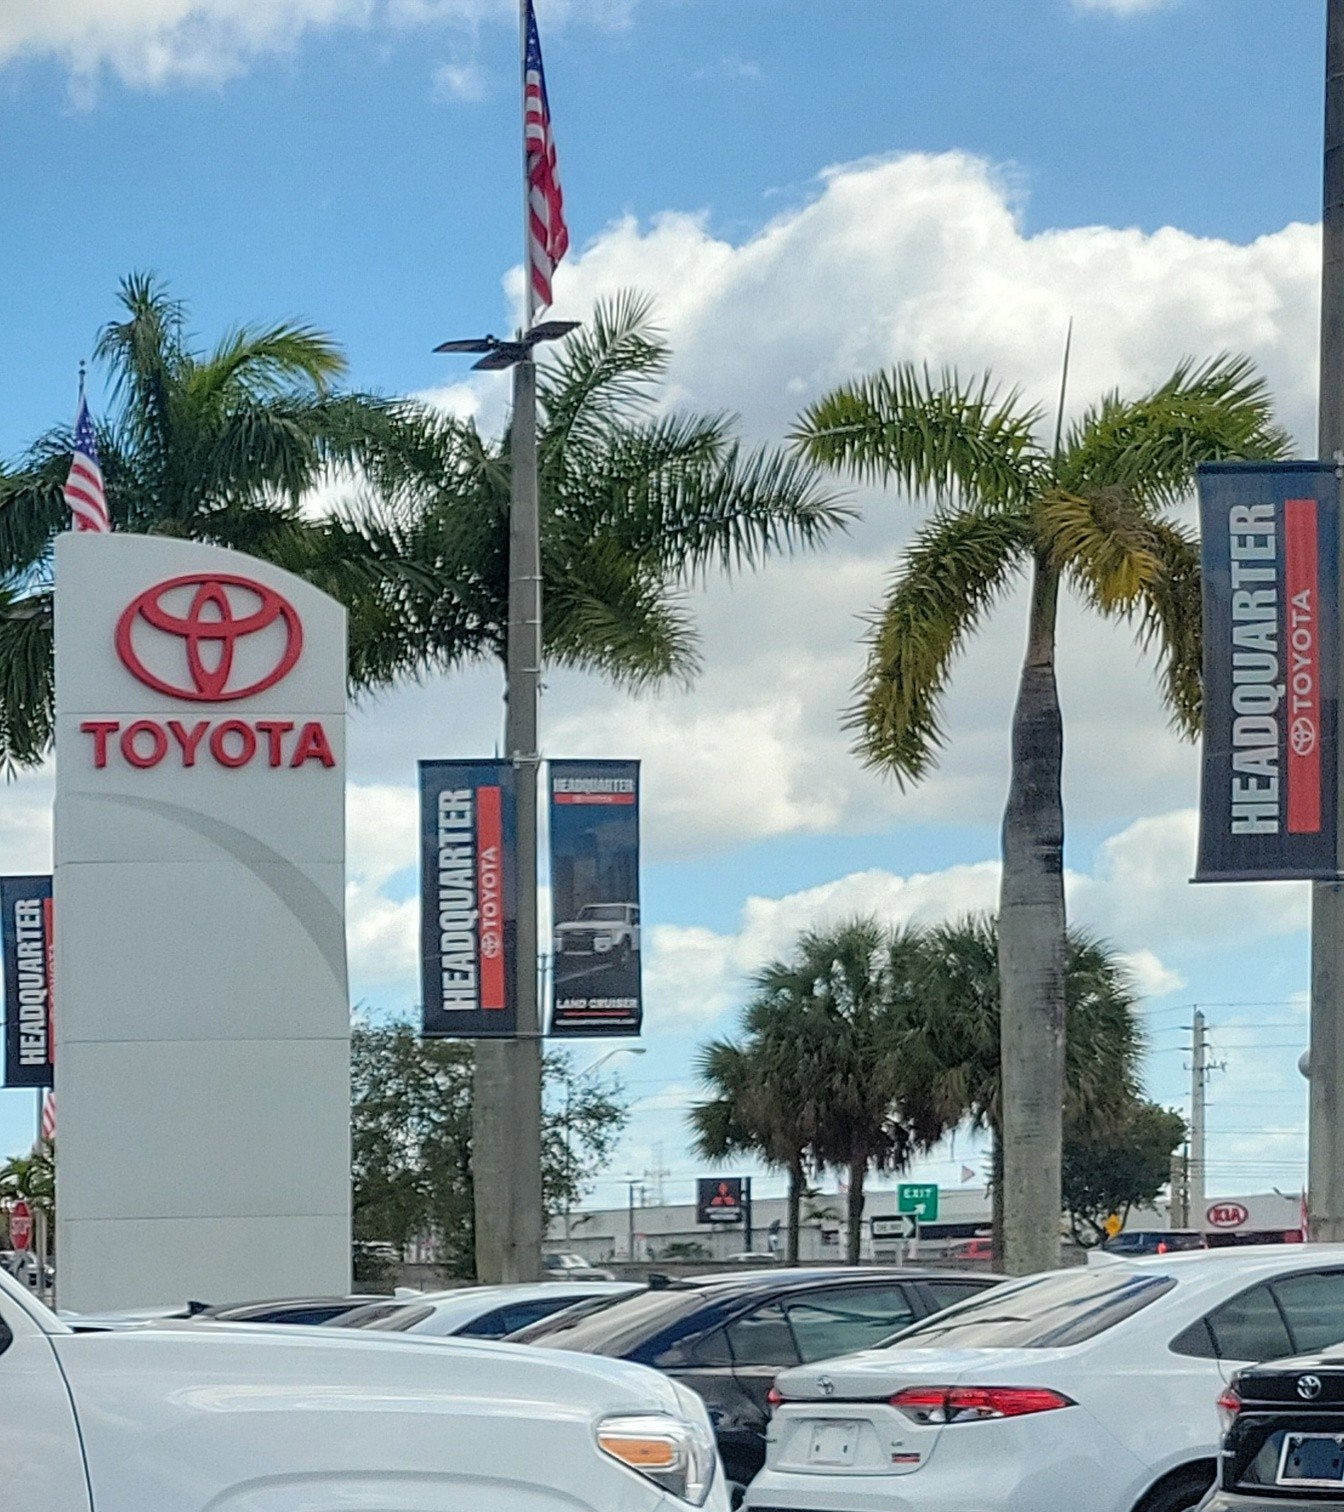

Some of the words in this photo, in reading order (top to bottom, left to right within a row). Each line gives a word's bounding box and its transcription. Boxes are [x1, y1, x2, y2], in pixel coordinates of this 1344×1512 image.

[1229, 502, 1285, 835] HEADQUARTER
[1291, 588, 1314, 714] TOYOTA
[80, 719, 336, 770] TOYOTA
[553, 777, 635, 794] HEADQUARTER
[437, 788, 479, 1013] HEADQUARTER
[480, 847, 499, 930] TOYOTA
[14, 898, 48, 1066] HEADQUARTER
[903, 1187, 933, 1199] EXIT
[1213, 1208, 1242, 1223] KIA
